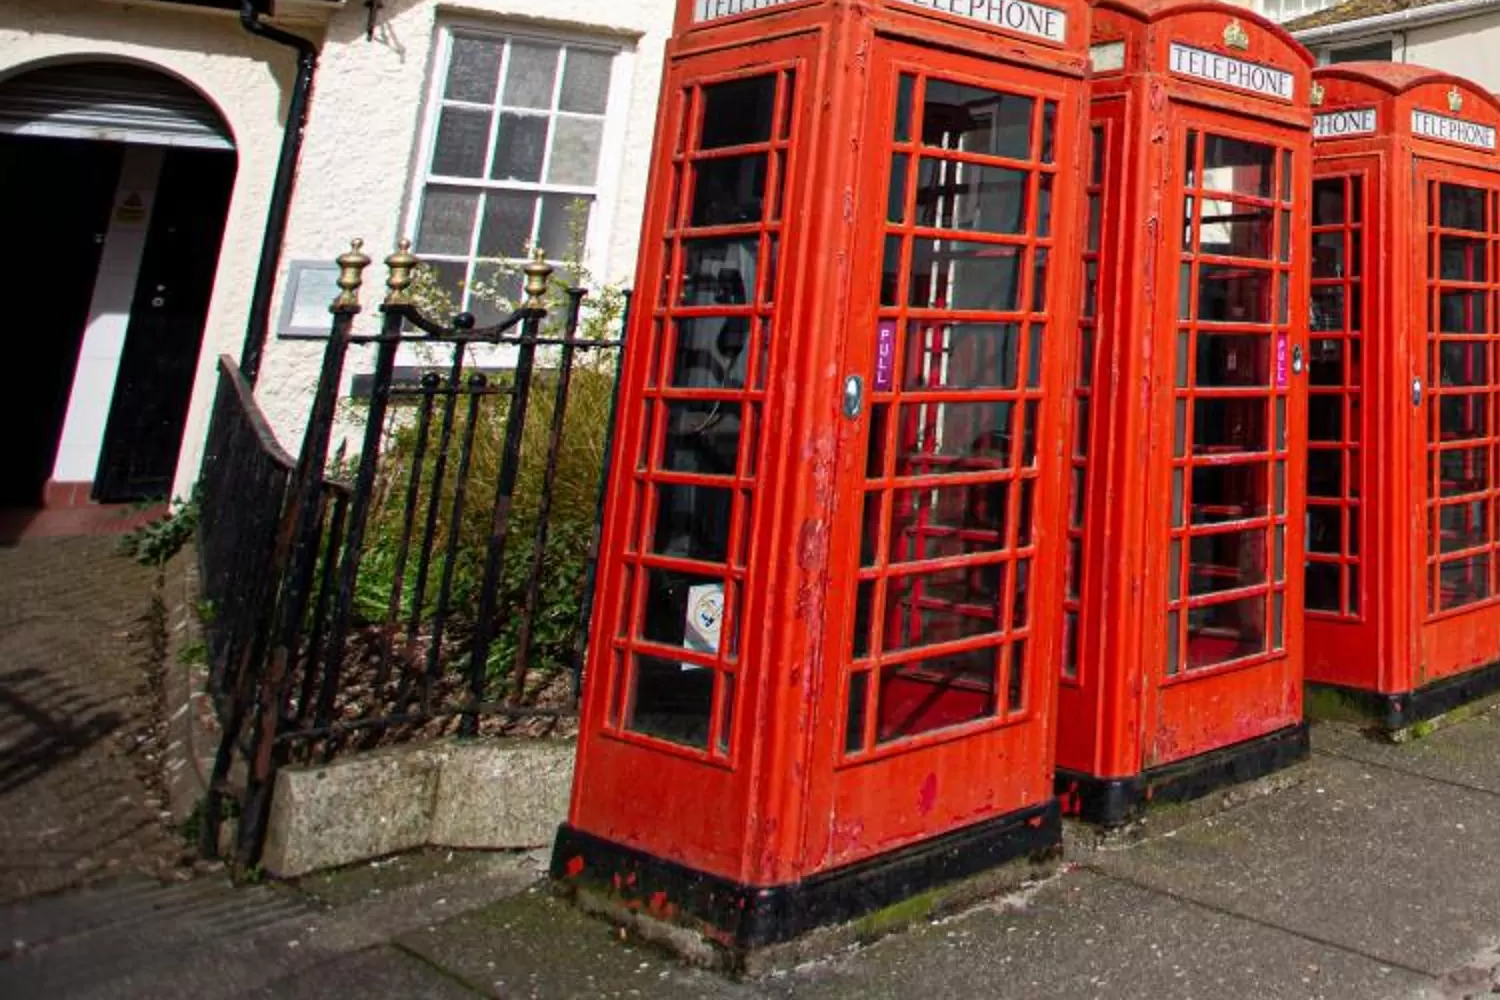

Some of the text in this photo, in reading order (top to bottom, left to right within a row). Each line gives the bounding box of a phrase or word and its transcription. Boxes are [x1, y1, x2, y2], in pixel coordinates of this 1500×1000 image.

[1173, 47, 1289, 97] TELEPHONE
[1312, 111, 1373, 135] PHONE
[1414, 113, 1492, 147] TELEPHONE
[876, 328, 891, 384] PULL
